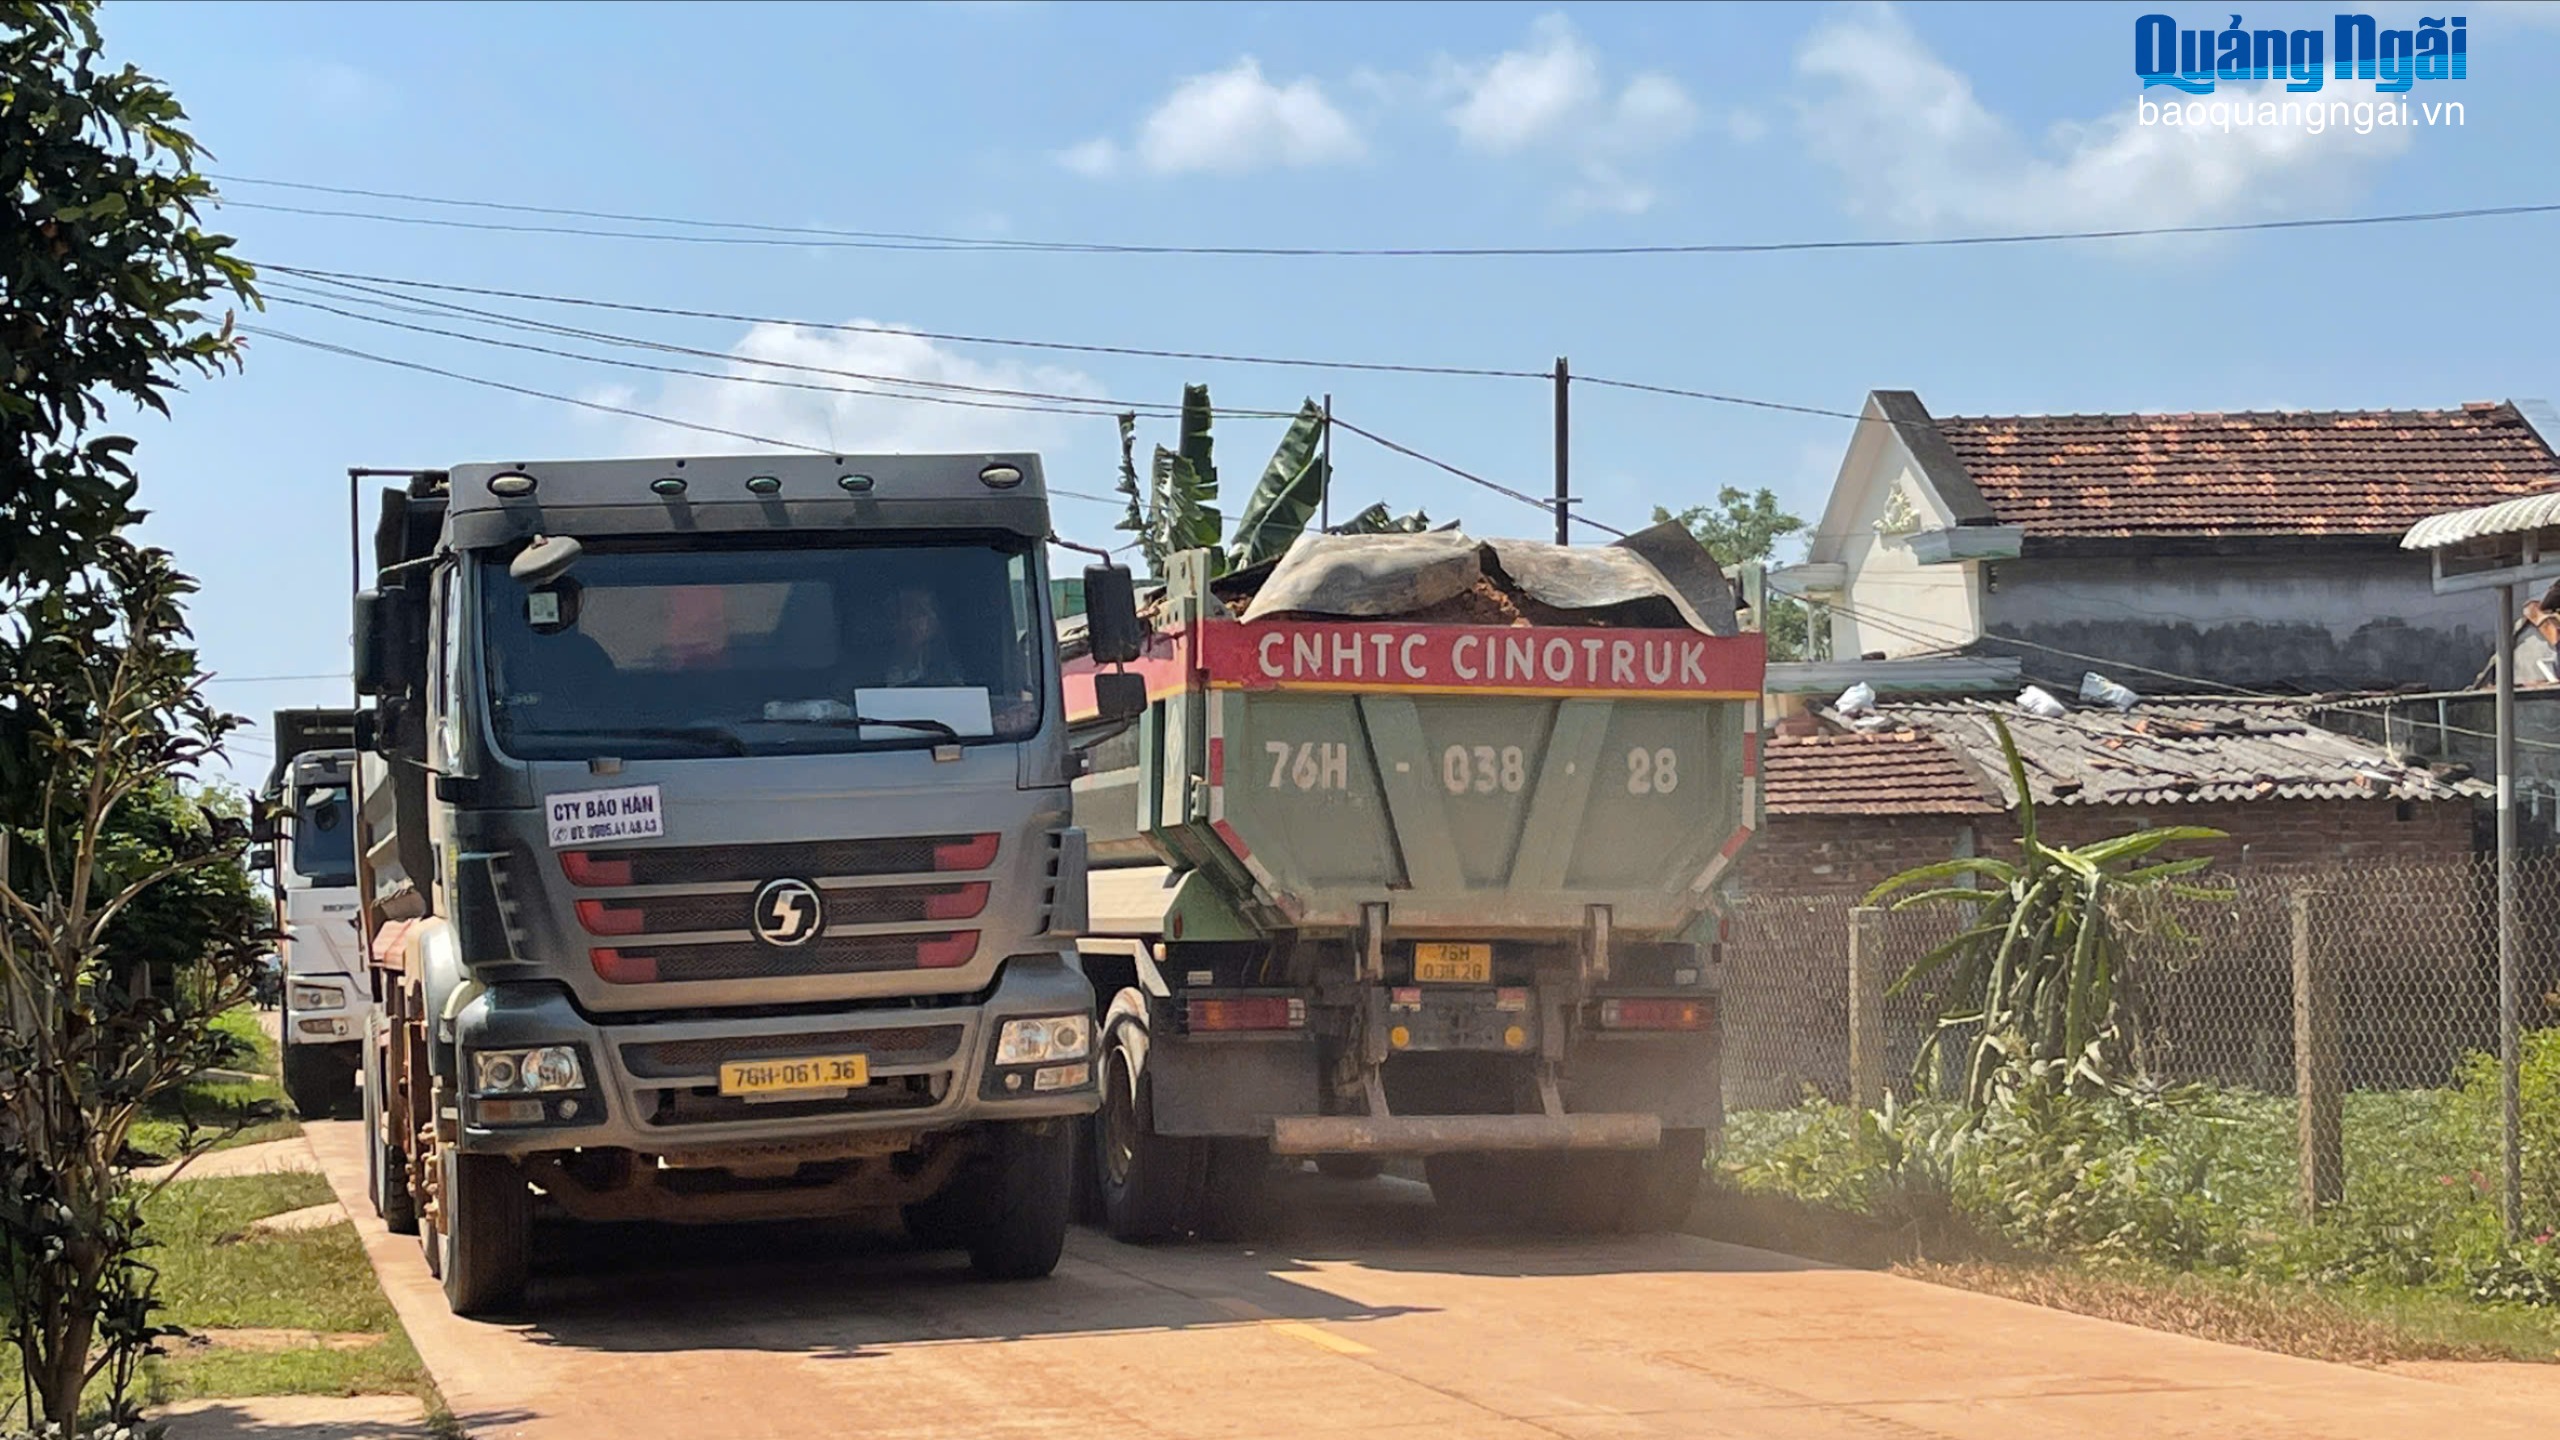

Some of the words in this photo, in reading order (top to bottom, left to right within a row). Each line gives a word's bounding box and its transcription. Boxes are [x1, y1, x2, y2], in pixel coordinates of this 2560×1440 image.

[1258, 631, 1428, 679] CNHTC
[1451, 635, 1708, 684] CINOTRUK
[1265, 741, 1348, 790] 76H
[1443, 744, 1526, 793] 038
[1627, 746, 1679, 795] 28
[553, 802, 581, 821] CTY
